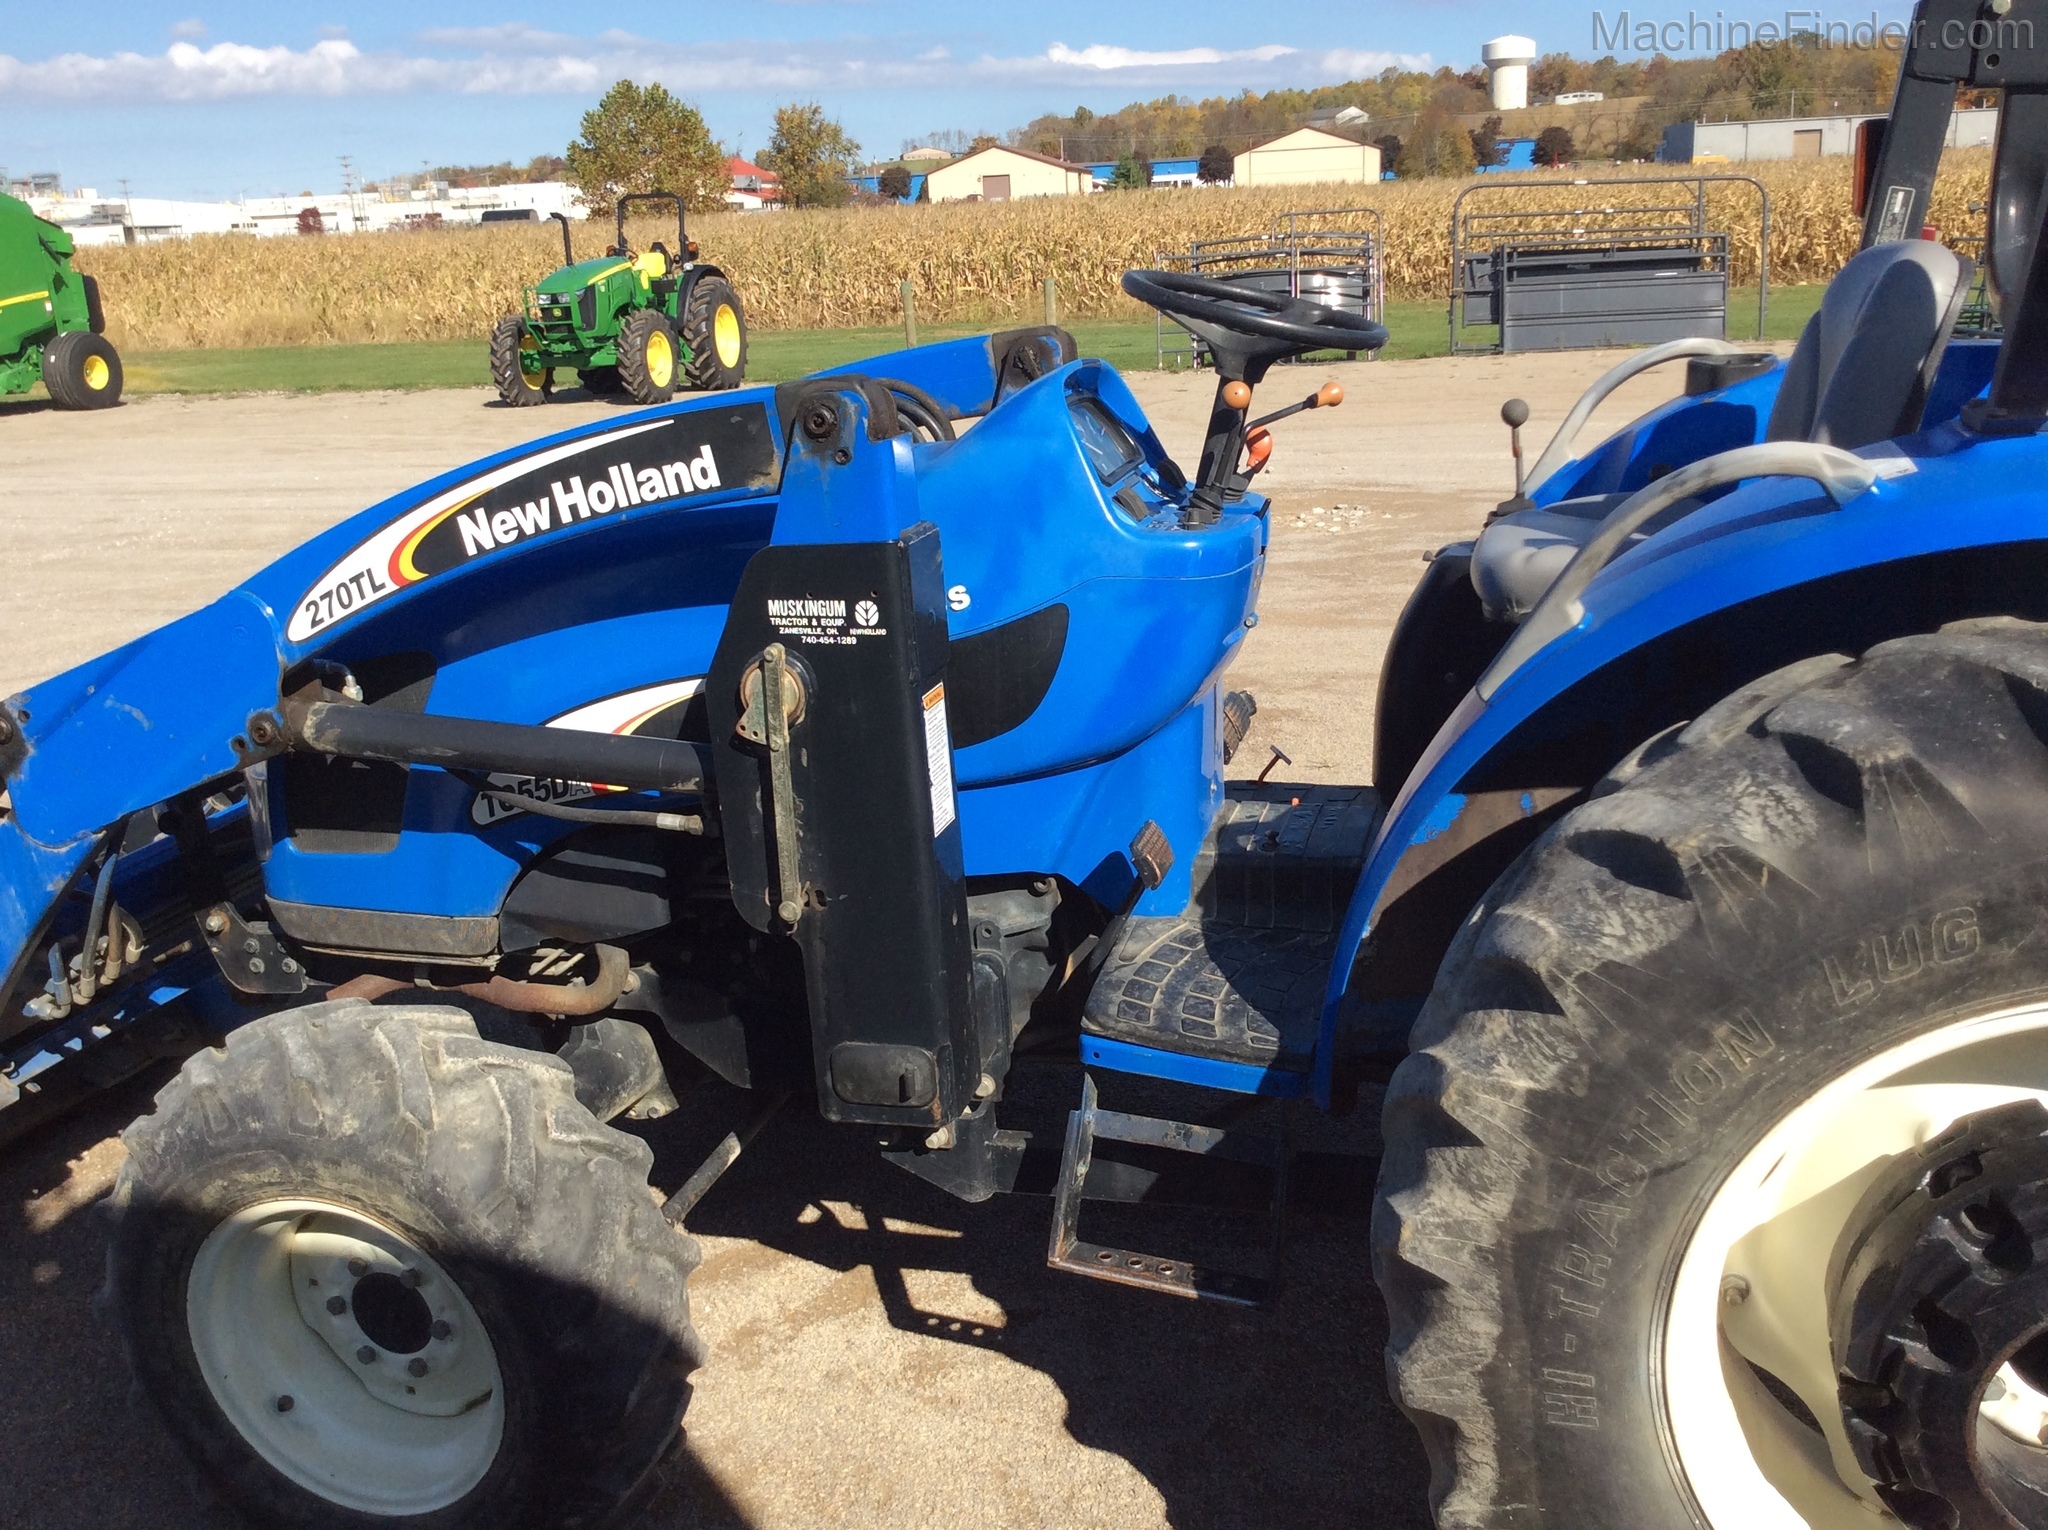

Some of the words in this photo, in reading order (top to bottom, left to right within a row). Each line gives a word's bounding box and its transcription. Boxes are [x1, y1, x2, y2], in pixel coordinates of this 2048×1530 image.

[550, 444, 721, 524] Holland
[304, 566, 387, 630] 270TL
[767, 599, 846, 617] MUSKINGUM
[769, 618, 809, 626] TRACTOR
[811, 618, 818, 626] &
[820, 618, 847, 627] EQUIP.
[779, 627, 824, 635] ZANESVILLE,
[801, 636, 857, 645] 740-454-1289
[1823, 907, 1980, 1007] LUG
